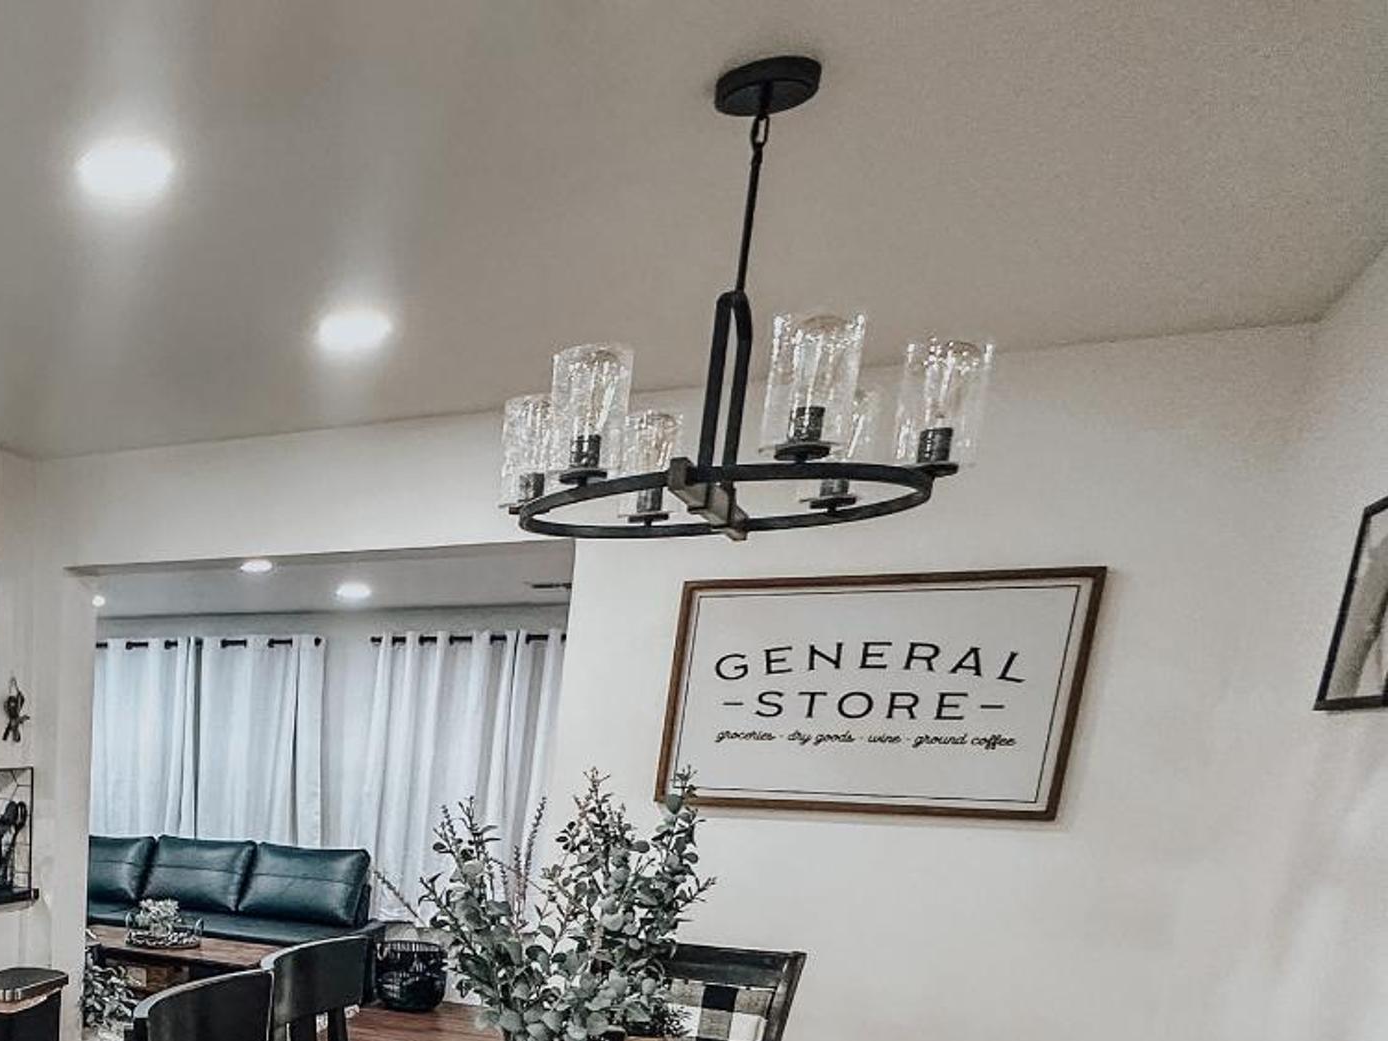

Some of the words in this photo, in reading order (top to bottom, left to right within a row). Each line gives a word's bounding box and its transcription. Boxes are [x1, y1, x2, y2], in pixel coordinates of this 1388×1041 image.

[715, 641, 1026, 684] GENERAL
[714, 730, 776, 743] groceries
[787, 729, 813, 746] dry
[812, 730, 856, 746] goods
[867, 733, 902, 744] wine
[912, 733, 968, 748] ground
[971, 734, 1017, 750] coffee
